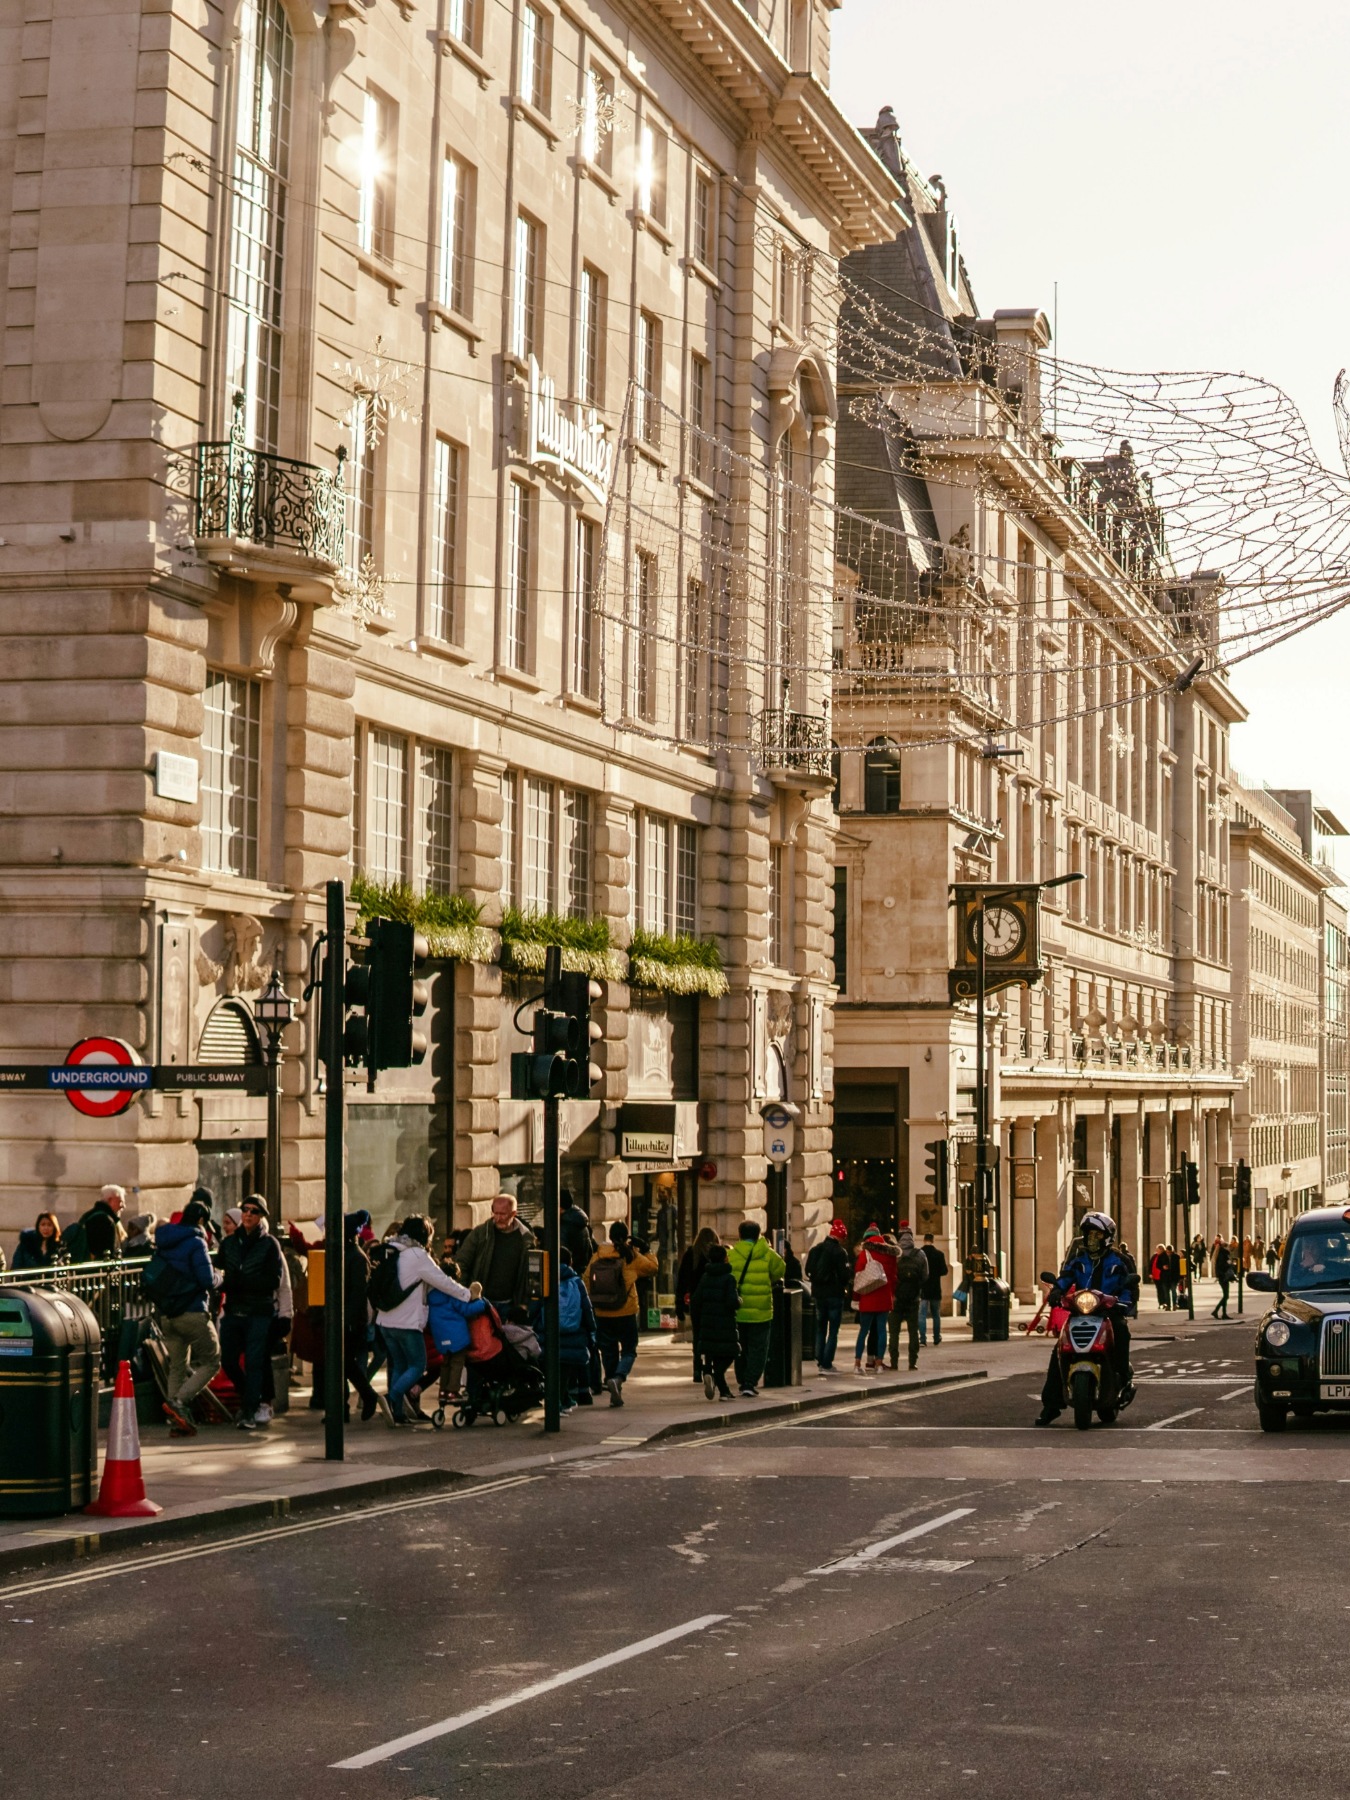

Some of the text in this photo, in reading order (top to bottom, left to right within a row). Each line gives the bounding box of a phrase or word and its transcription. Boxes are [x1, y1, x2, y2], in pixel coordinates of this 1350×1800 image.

[527, 353, 612, 490] Lillywhites
[0, 1073, 26, 1082] BWAY
[51, 1072, 148, 1084] UNDERGROUND
[176, 1074, 245, 1082] PUBLIC SUBWAY
[625, 1137, 670, 1154] Lillywhites
